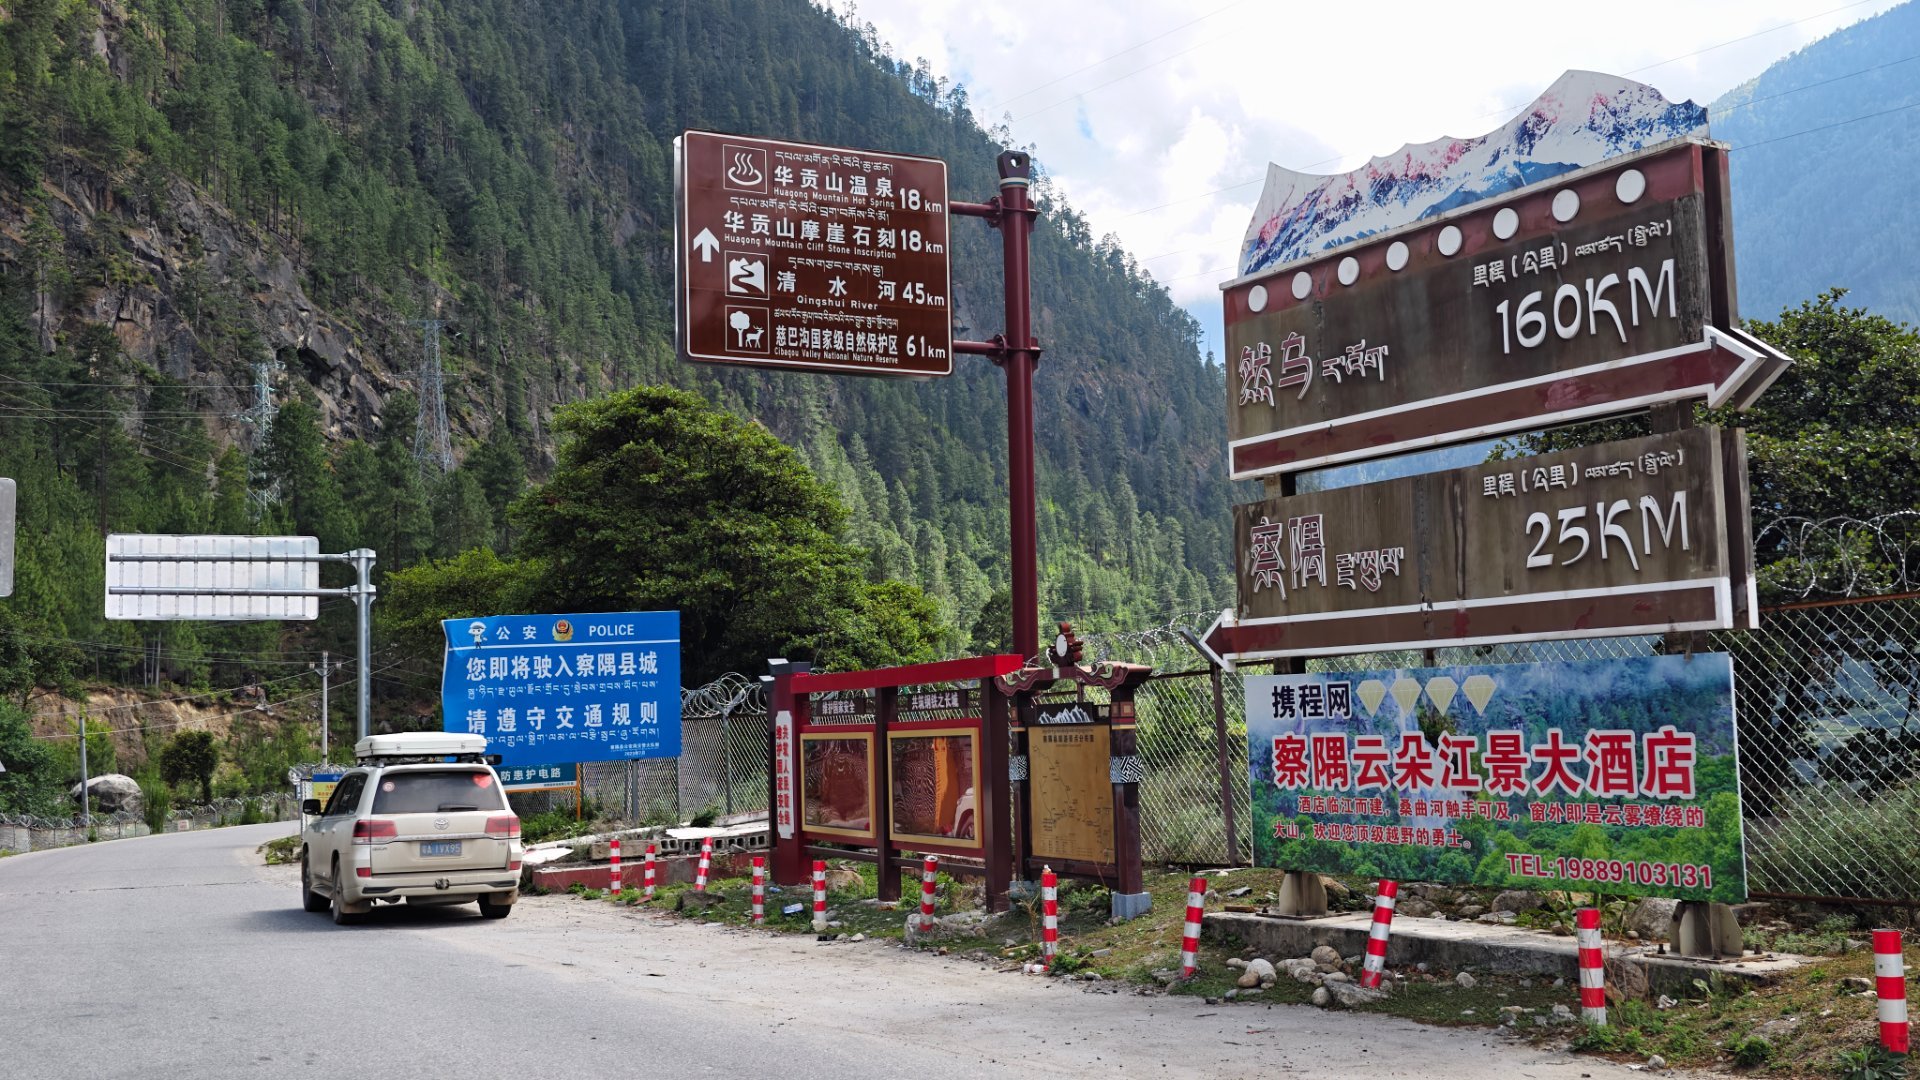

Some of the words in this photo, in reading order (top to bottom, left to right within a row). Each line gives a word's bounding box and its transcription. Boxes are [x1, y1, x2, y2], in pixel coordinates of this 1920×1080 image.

[773, 187, 808, 201] Huagong
[812, 190, 849, 203] Mountain
[852, 195, 866, 205] Hot
[870, 197, 895, 210] Spring
[774, 165, 894, 198] 华贡山温泉
[899, 188, 921, 211] 18
[924, 200, 942, 213] km
[723, 210, 896, 250] 华贡山摩崖石刻
[900, 229, 922, 252] 18
[925, 241, 944, 254] km
[724, 233, 760, 247] Huagong
[764, 237, 803, 251] Mountain
[807, 240, 824, 252] Cliff
[828, 243, 850, 255] Stone
[853, 246, 896, 259] Inscription
[776, 270, 896, 302] 清水河
[850, 299, 878, 311] River
[1496, 258, 1676, 354] 160KM
[774, 347, 799, 358] Cibagou
[801, 349, 821, 360] Valley
[824, 351, 849, 361] National
[852, 353, 873, 362] Nature
[875, 354, 898, 364] Reserve
[775, 325, 898, 355] 慈巴沟国家级自然保护区
[1238, 331, 1313, 406] 然乌
[1526, 490, 1690, 570] 25KM
[1250, 514, 1328, 600] 察隅
[496, 625, 537, 640] 公安
[589, 624, 634, 637] POLICE
[466, 651, 658, 681] 您即将驶入察隅县城
[1272, 680, 1351, 720] 携程网
[466, 701, 658, 734] 请遵守交通规则
[1272, 727, 1695, 797] 察隅云朵江景大酒店
[1505, 851, 1712, 889] TEL:19889103131
